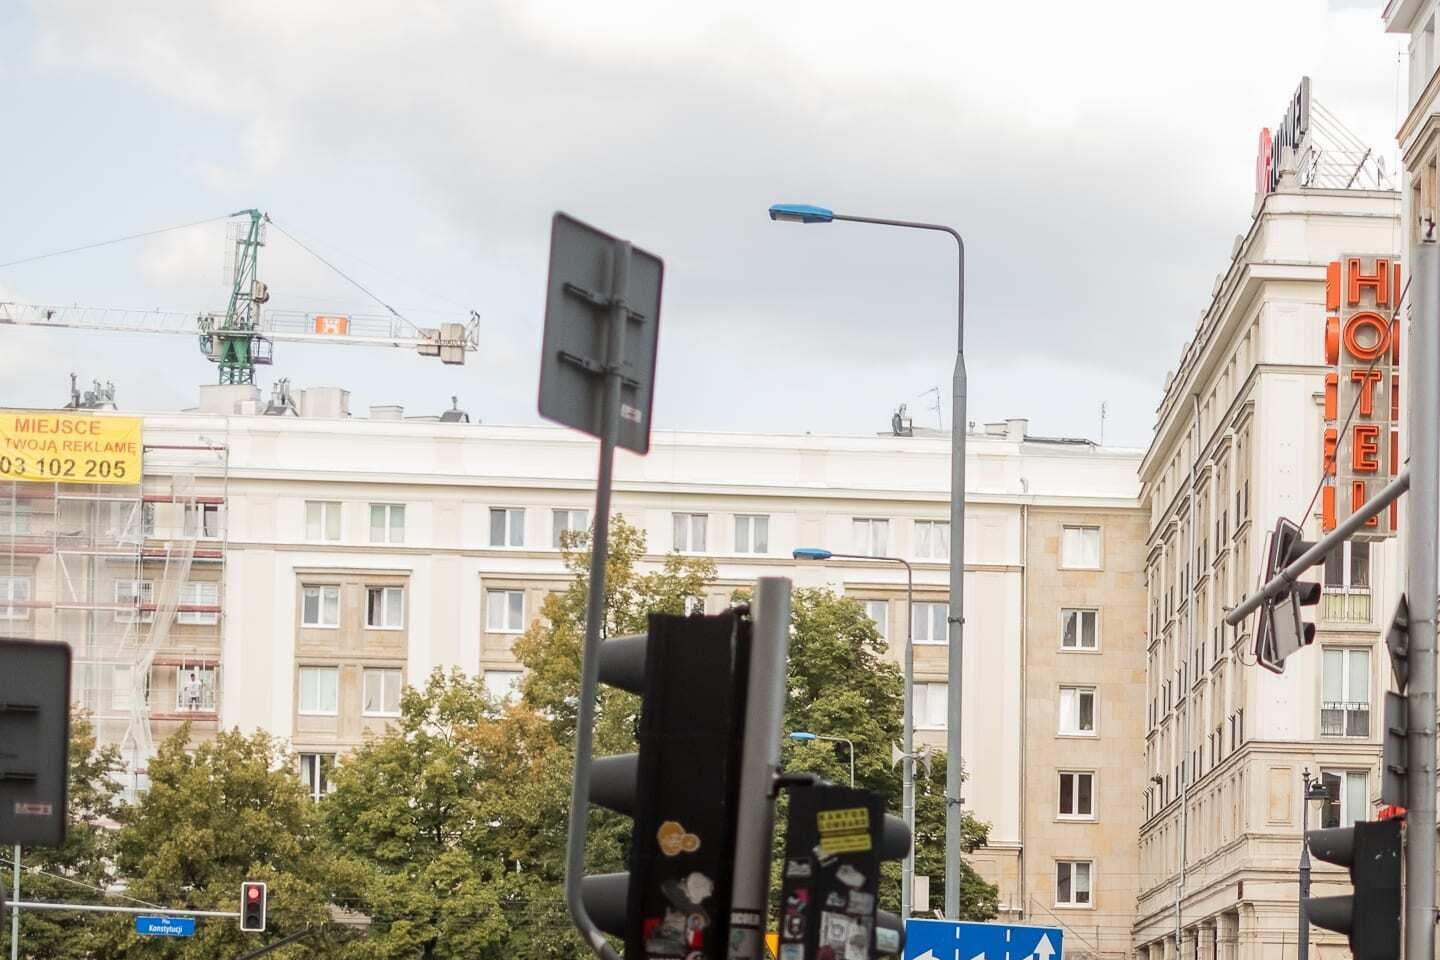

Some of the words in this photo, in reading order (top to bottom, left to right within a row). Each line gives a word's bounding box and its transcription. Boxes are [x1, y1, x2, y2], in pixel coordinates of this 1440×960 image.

[1343, 258, 1391, 527] HOTEL
[15, 418, 101, 435] MIEJSCE
[5, 438, 58, 454] TWOJĄ
[63, 440, 137, 456] REKLAMĘ
[37, 458, 76, 476] 102
[85, 459, 126, 478] 205
[148, 924, 183, 935] Konstytucji
